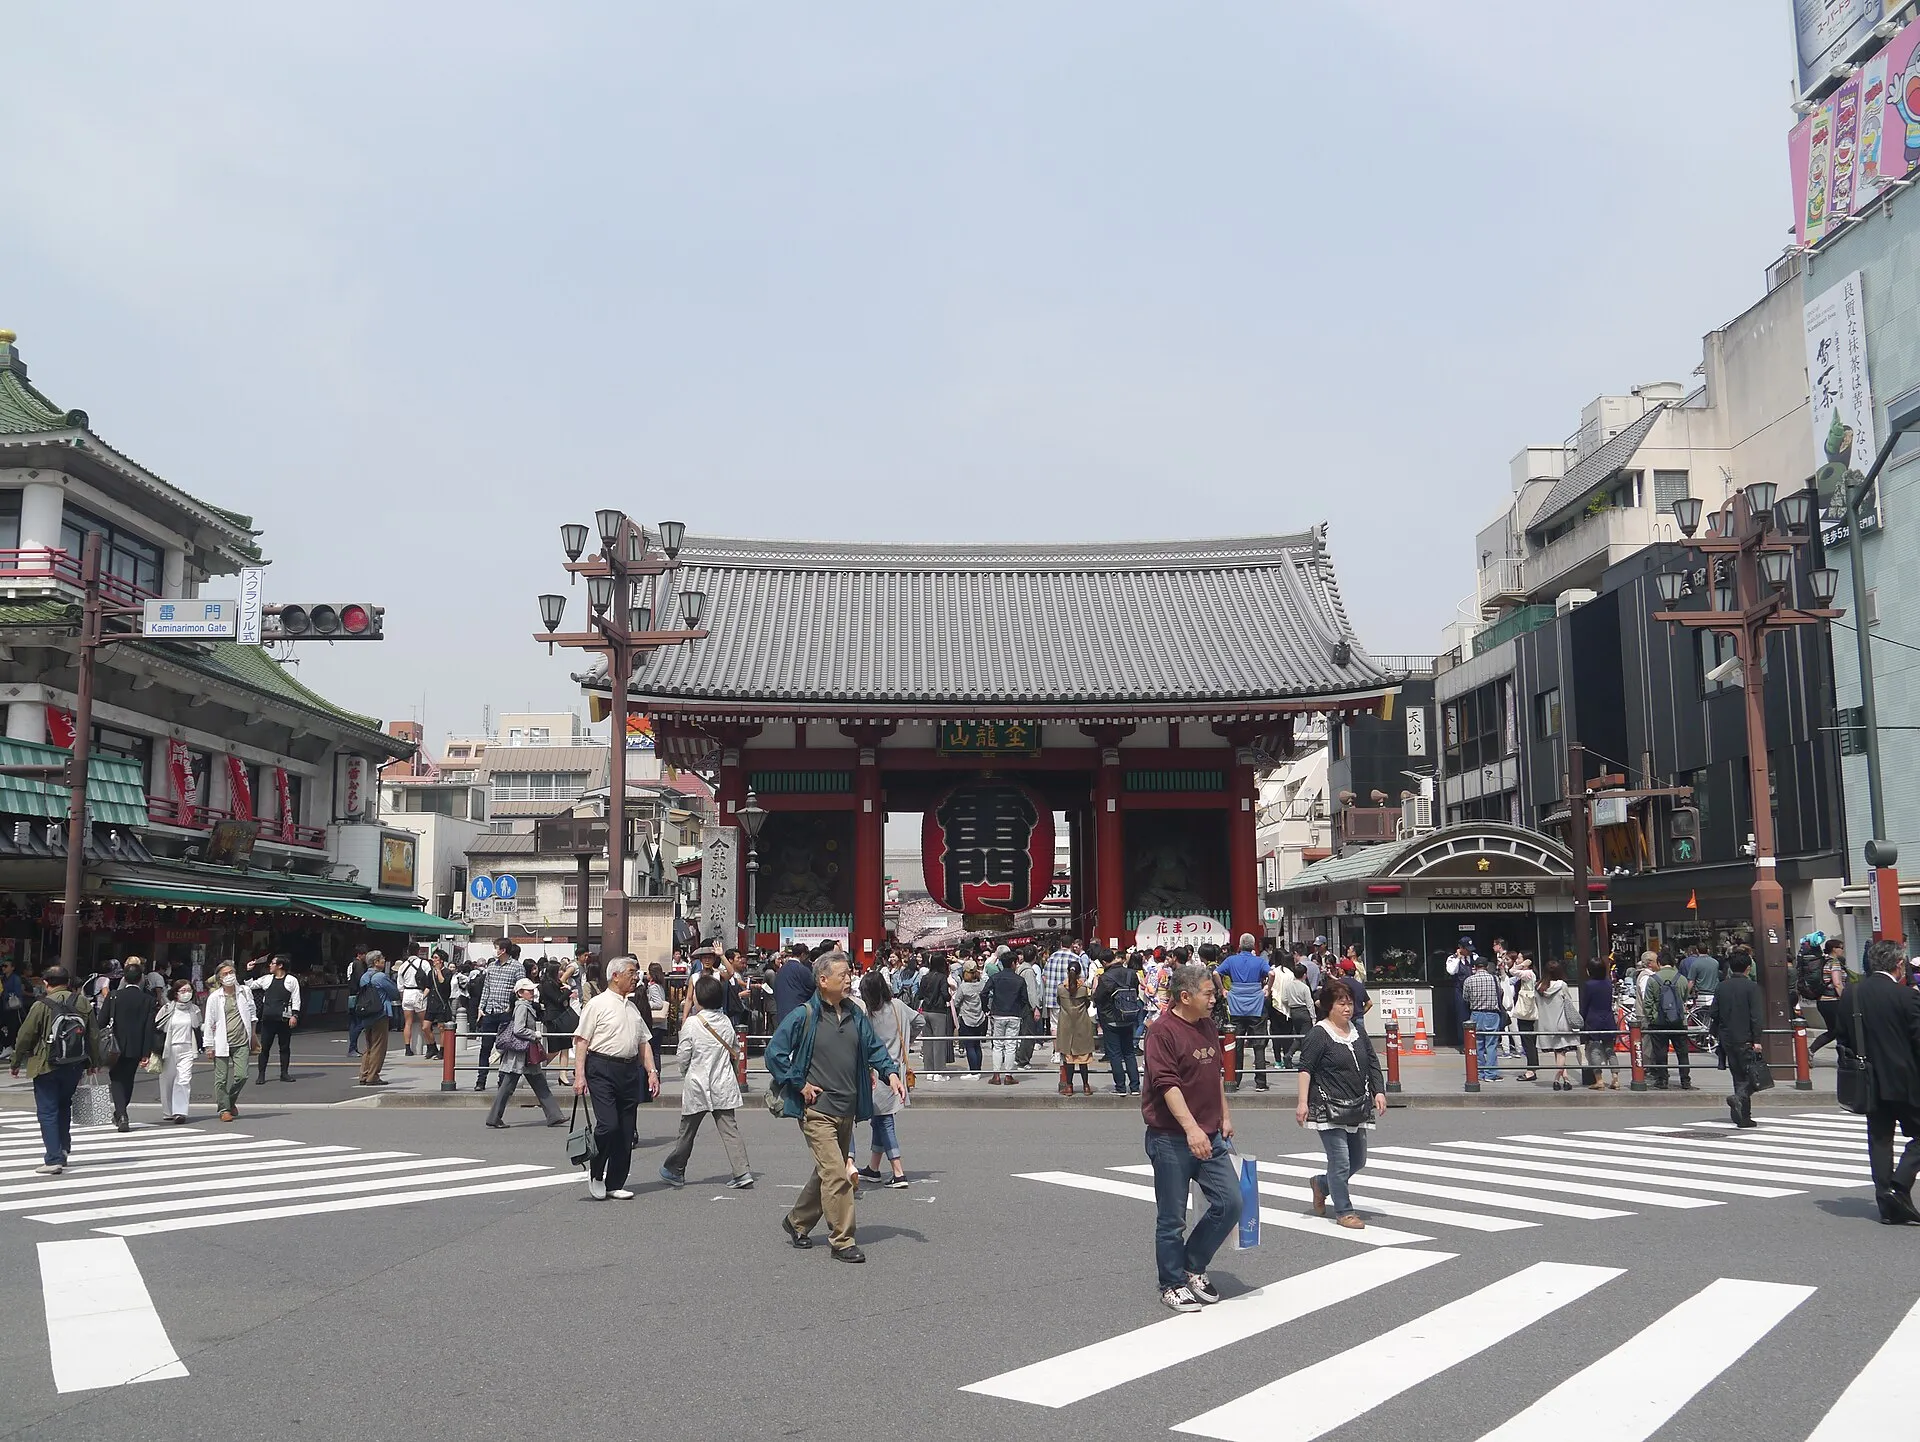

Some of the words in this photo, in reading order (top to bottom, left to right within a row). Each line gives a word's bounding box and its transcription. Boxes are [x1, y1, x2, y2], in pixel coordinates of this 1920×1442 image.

[160, 604, 221, 620] 雷門
[243, 571, 258, 642] スクランブル式
[151, 624, 204, 632] Kaminarimon
[207, 624, 227, 632] Gate
[1408, 711, 1422, 751] 天ぷら
[935, 784, 1040, 912] 雷門
[1480, 881, 1537, 895] 雷門交番
[1157, 922, 1212, 934] 花まつり
